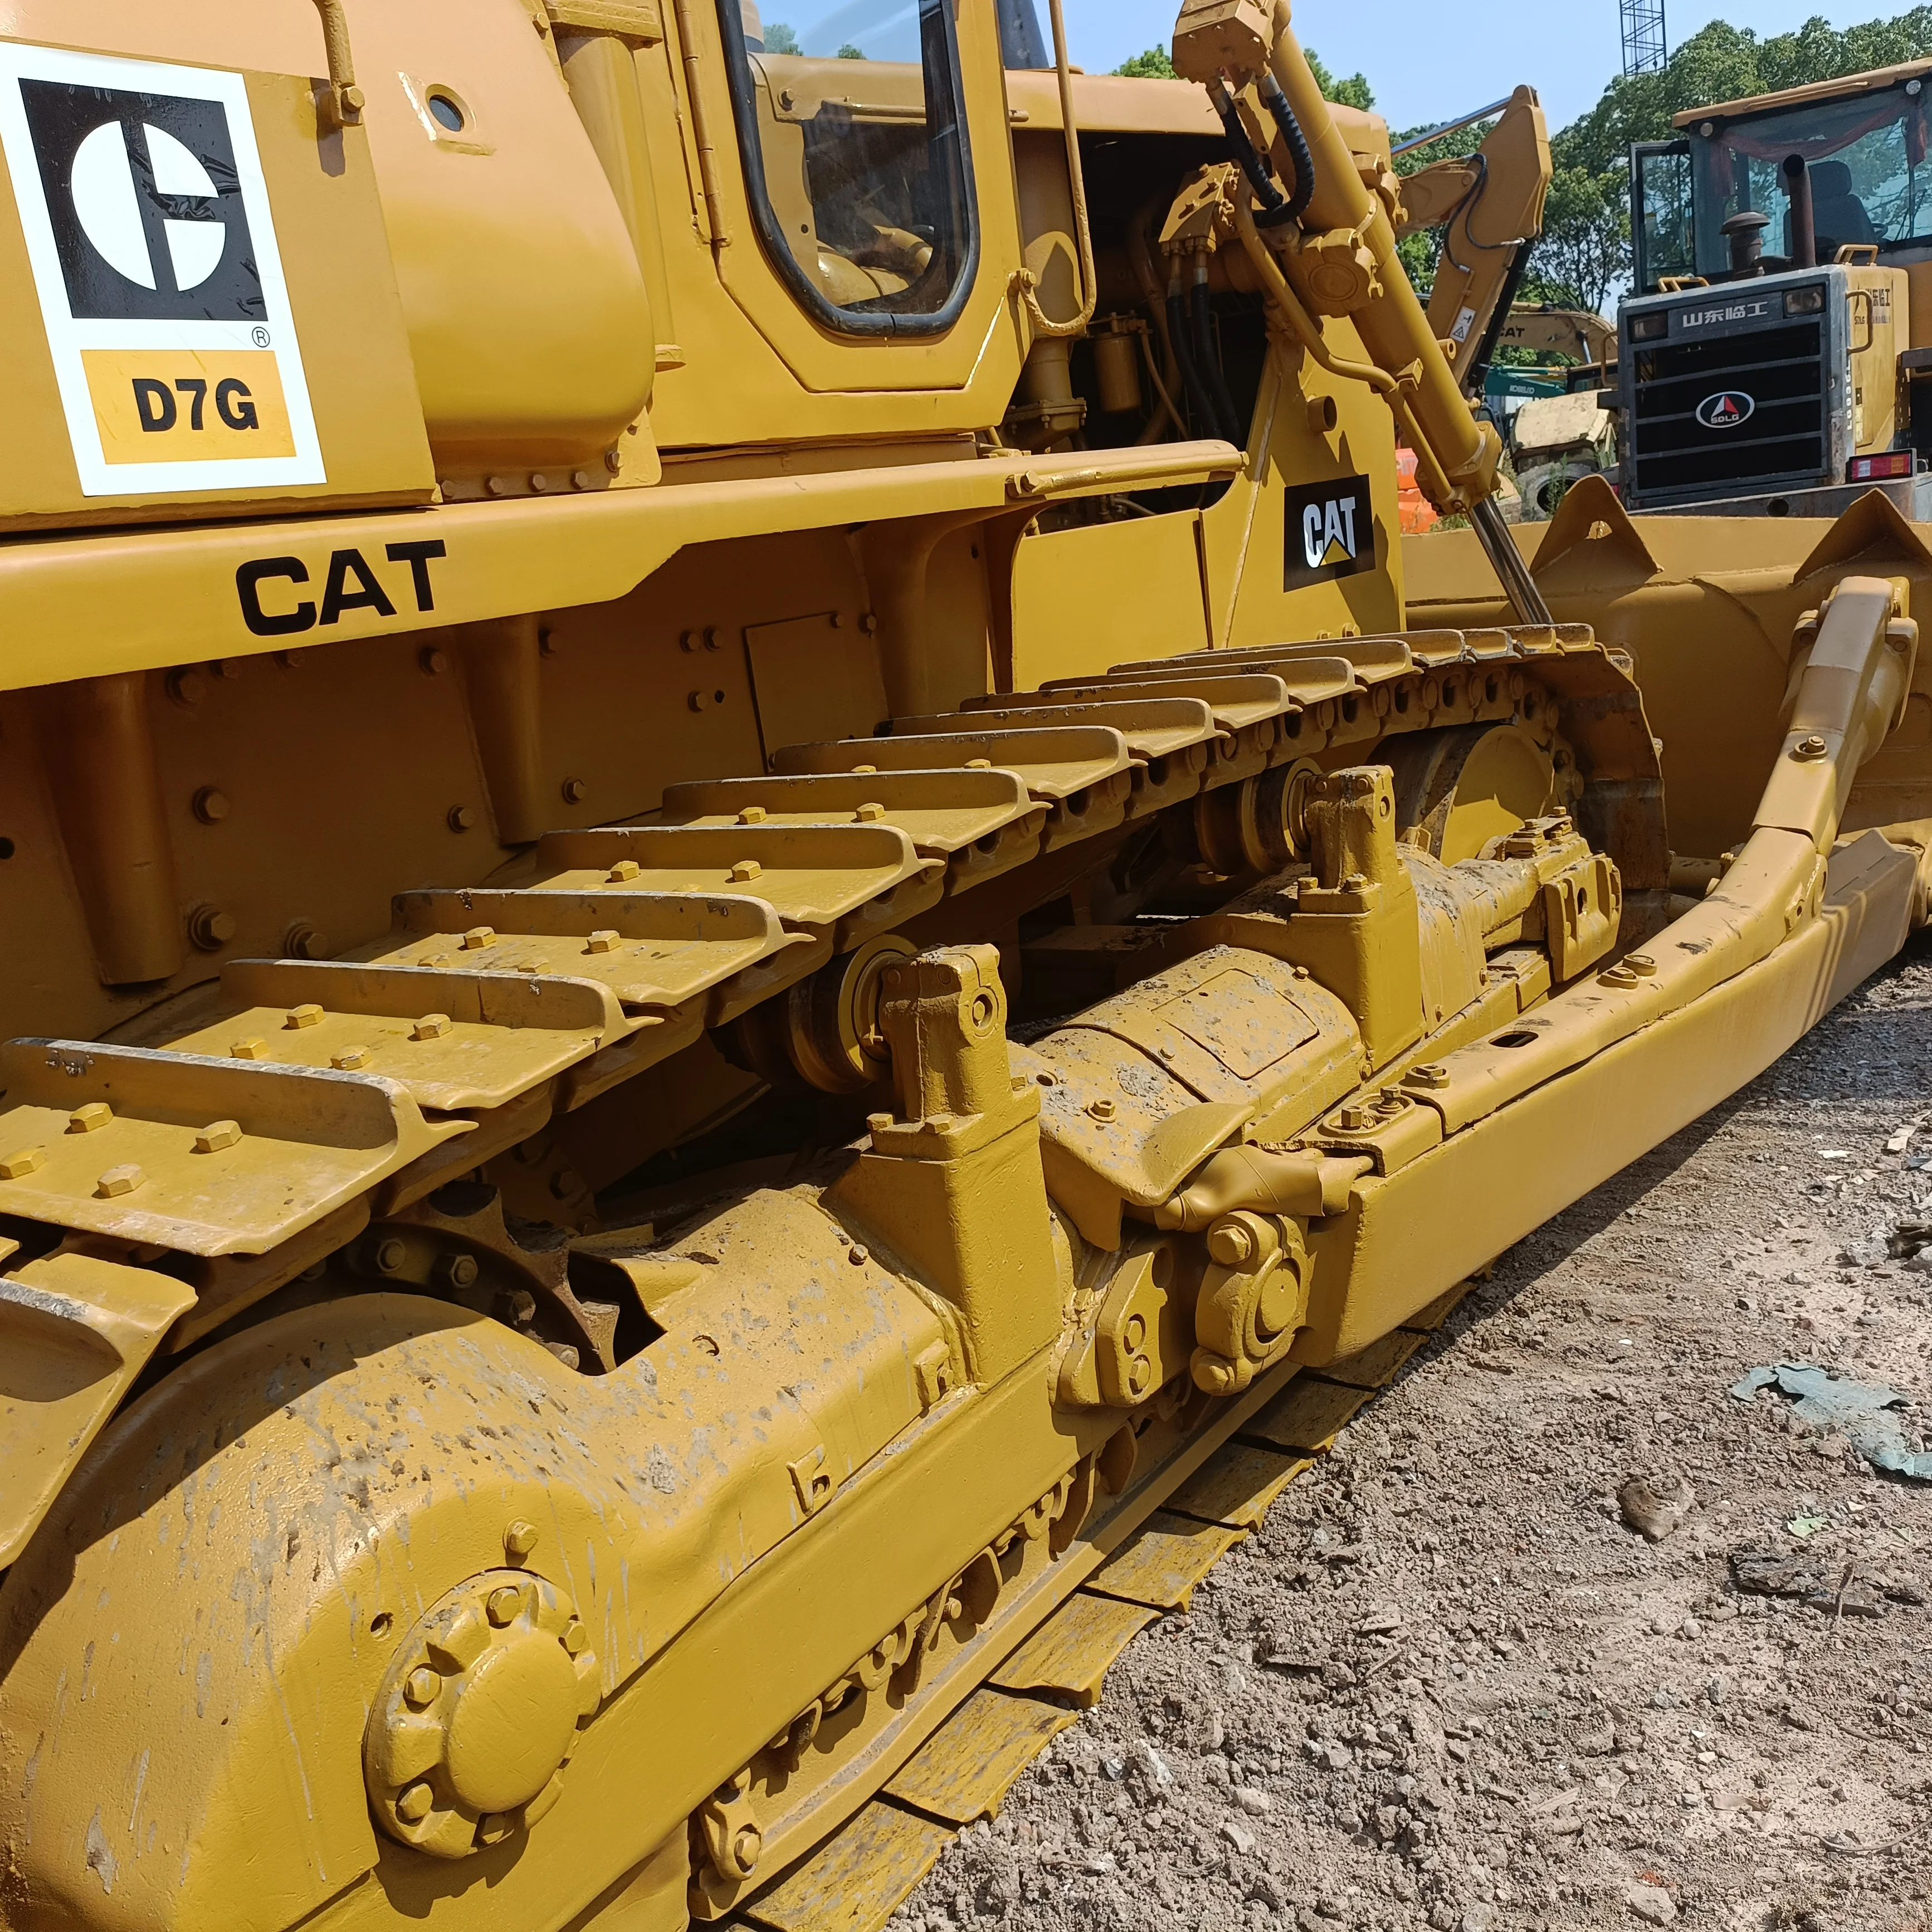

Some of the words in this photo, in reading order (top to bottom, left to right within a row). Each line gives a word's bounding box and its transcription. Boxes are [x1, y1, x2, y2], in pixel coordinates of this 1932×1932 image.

[1683, 301, 1768, 328] 山东临工
[132, 378, 259, 432] D7G
[1711, 413, 1739, 423] SDLG
[1303, 496, 1356, 568] CAT
[236, 539, 446, 636] CAT
